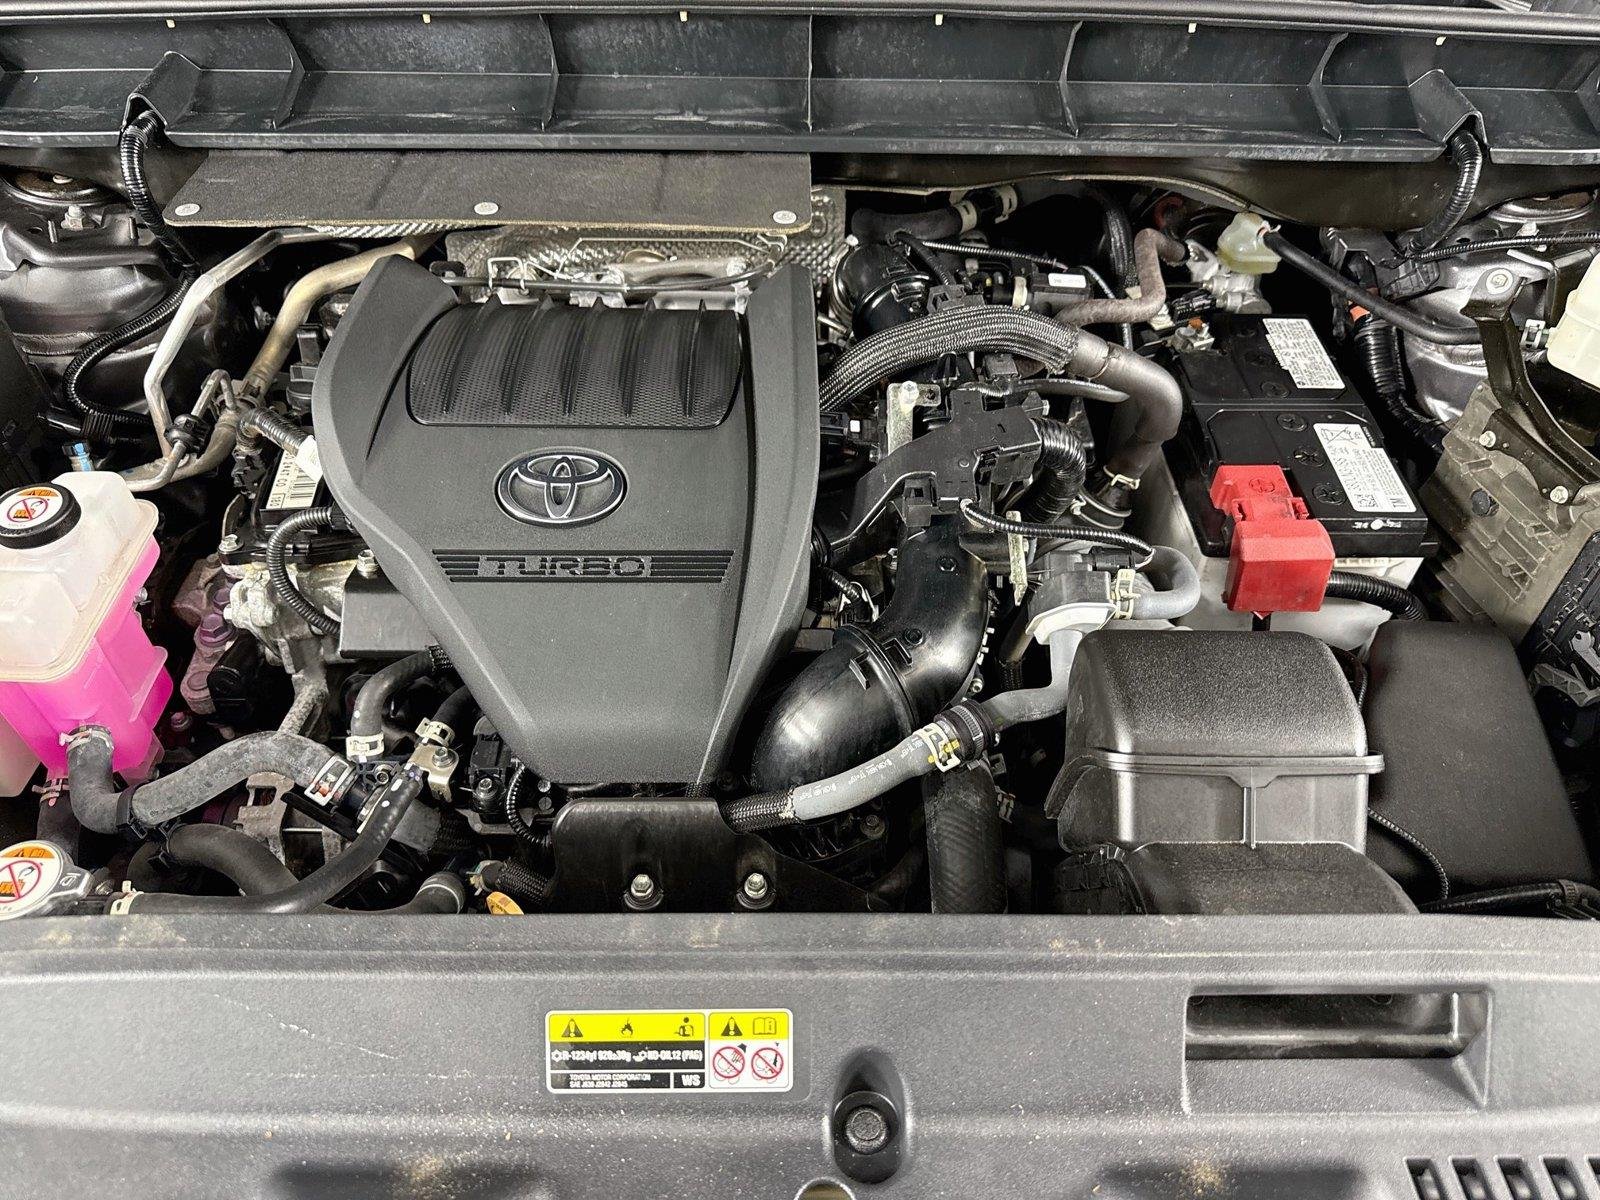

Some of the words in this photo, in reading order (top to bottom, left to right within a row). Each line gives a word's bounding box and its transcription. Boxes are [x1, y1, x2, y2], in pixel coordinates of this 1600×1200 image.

[484, 556, 646, 576] TURBO
[561, 1050, 597, 1062] R-1234yf
[682, 1050, 703, 1062] (PAG)
[570, 1073, 591, 1081] TOYOTA
[592, 1073, 612, 1081] MOTOR
[612, 1073, 651, 1081] CORPORATION
[681, 1074, 701, 1086] WS
